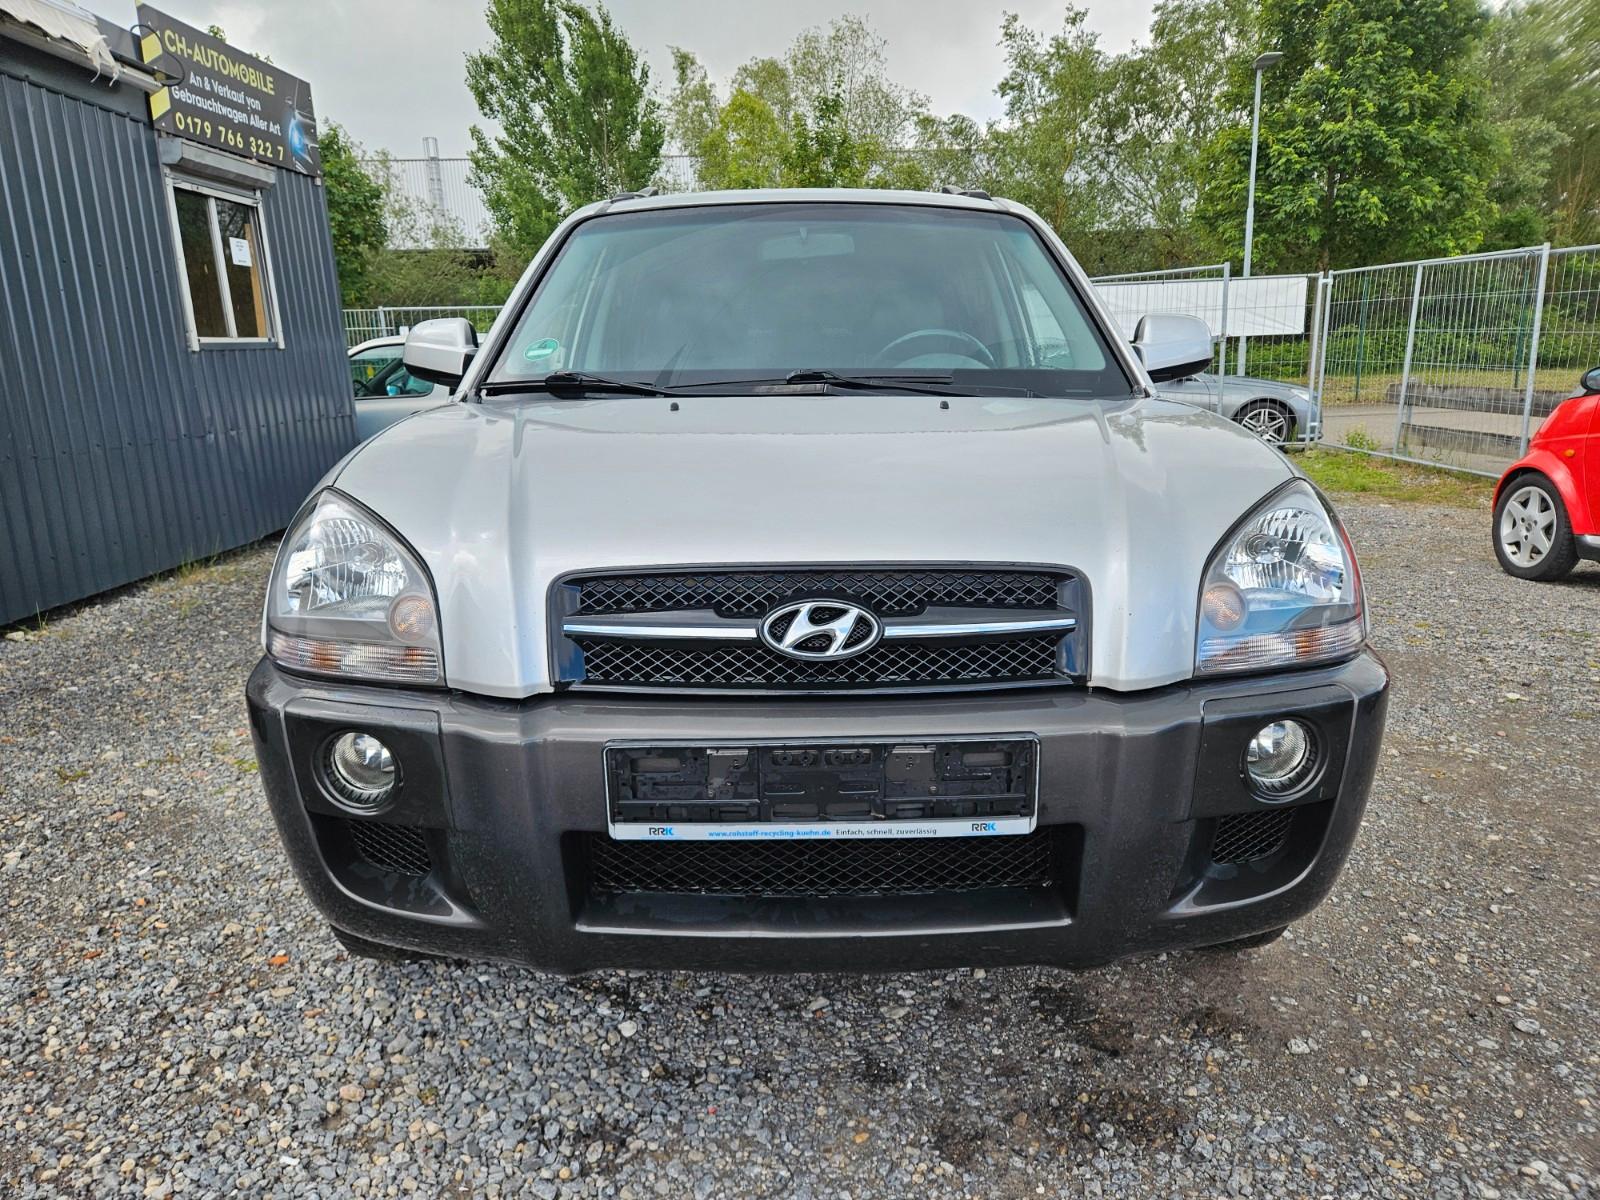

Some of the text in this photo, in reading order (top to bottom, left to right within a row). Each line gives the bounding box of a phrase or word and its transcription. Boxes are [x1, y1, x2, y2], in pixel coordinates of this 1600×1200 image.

[164, 29, 275, 95] CH-AUTOMOBILE
[189, 71, 203, 87] An
[203, 76, 211, 91] &
[211, 79, 245, 103] Verkauf
[171, 85, 281, 136] Gebrauchtwagen Aller Art
[175, 111, 284, 160] 0179 766 322 7
[648, 826, 674, 836] RRK
[836, 828, 864, 837] Einfach,
[971, 822, 997, 832] RRK
